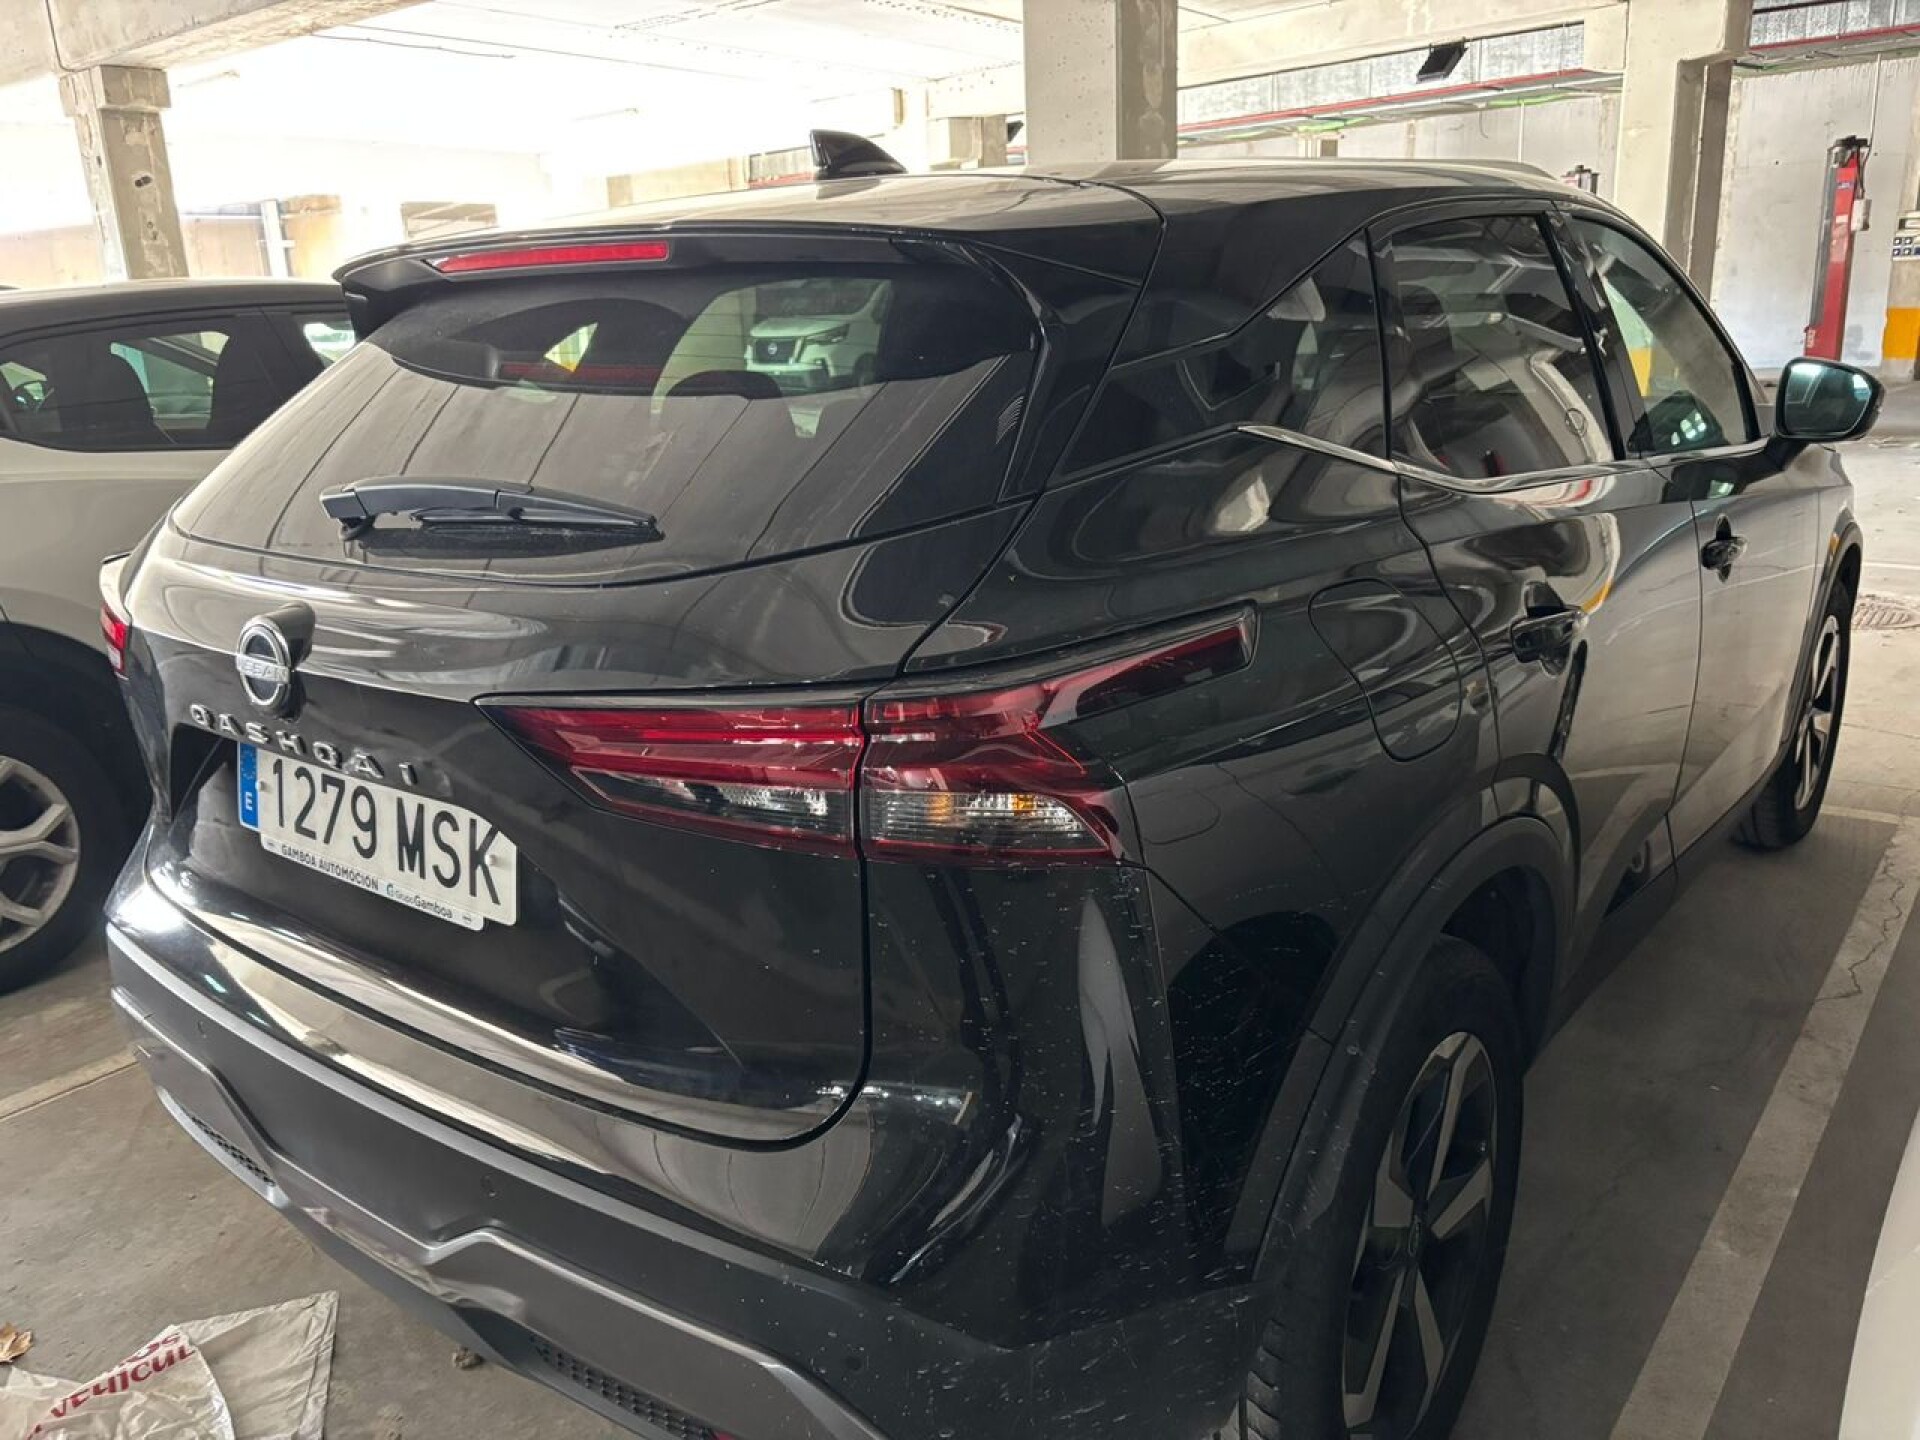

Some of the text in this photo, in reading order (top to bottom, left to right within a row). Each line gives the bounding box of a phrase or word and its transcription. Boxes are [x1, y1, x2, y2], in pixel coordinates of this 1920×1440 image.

[189, 703, 416, 787] QASHQAI
[244, 791, 253, 811] E
[272, 758, 501, 906] 1279 MSK
[281, 844, 316, 865] GAMBOA
